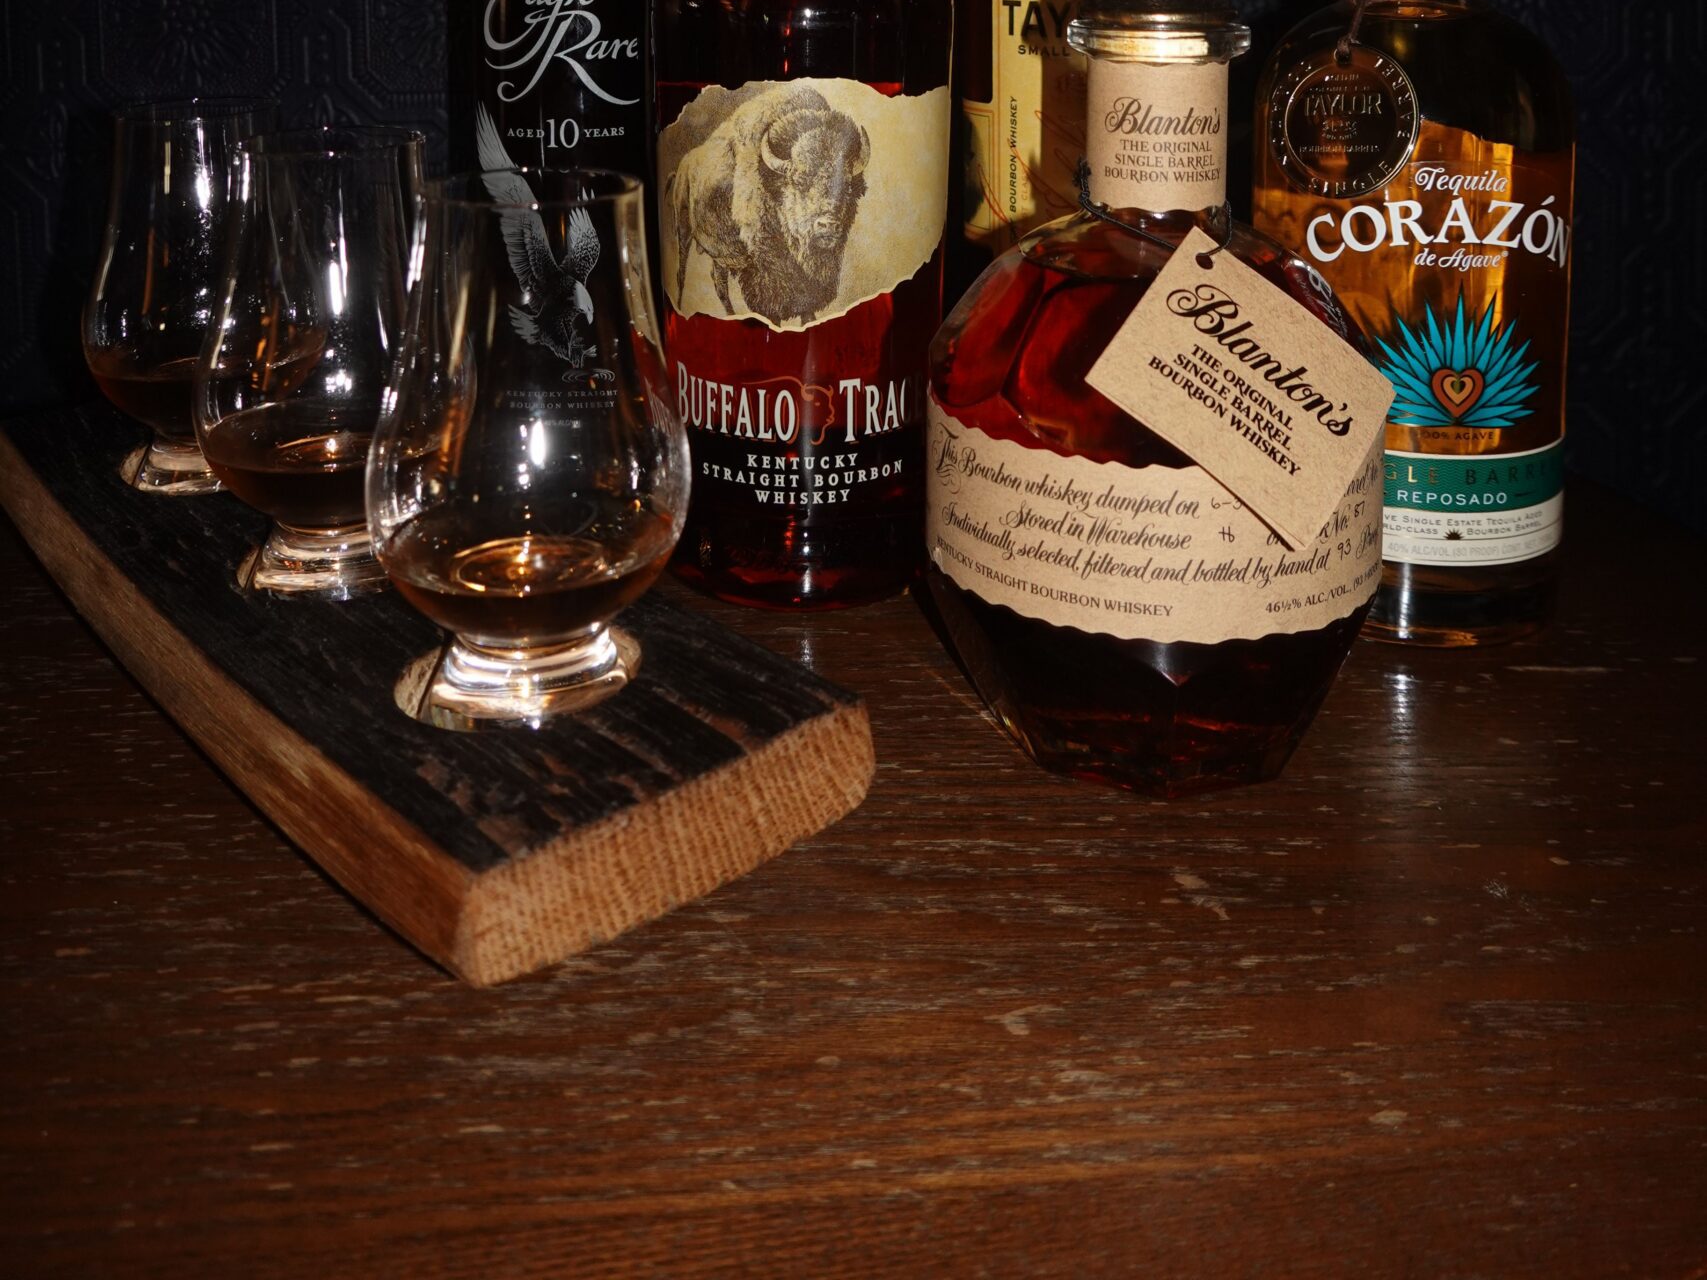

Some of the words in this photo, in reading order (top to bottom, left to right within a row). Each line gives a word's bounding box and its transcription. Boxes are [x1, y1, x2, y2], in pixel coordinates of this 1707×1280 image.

[1002, 0, 1072, 38] TAY
[497, 9, 640, 105] Rare
[1018, 44, 1071, 57] SMALL
[1009, 96, 1018, 148] WHISKEY
[1104, 96, 1220, 136] Blanton's
[1304, 92, 1382, 117] TAYLOR
[507, 128, 545, 138] AGED
[546, 118, 580, 148] 10
[584, 126, 625, 138] YEARS
[1120, 138, 1149, 152] THE
[1152, 140, 1212, 155] ORIGINAL
[1104, 166, 1169, 183] BOURBON
[1173, 170, 1221, 182] WHISKEY
[1114, 153, 1162, 168] SINGLE
[1168, 156, 1215, 169] BARREL
[1310, 161, 1393, 195] SINGLE
[1009, 155, 1017, 213] BOURBON
[1414, 167, 1508, 196] Tequila
[1306, 195, 1571, 268] CORAZÓN
[1414, 248, 1436, 267] de
[1166, 283, 1353, 437] Blanton's
[677, 360, 796, 442] BUFFALO
[1173, 353, 1229, 400] SINGLE
[1230, 396, 1291, 451] BARREL
[1192, 344, 1221, 372] THE
[1223, 368, 1294, 431] ORIGINAL
[1148, 355, 1228, 419] BOURBON
[1229, 415, 1301, 478] WHISKEY
[1423, 431, 1449, 440] 00%
[1455, 430, 1494, 440] AGAVE
[703, 462, 799, 487] STRAIGHT
[814, 459, 903, 487] BOURBON
[747, 453, 858, 470] KENTUCKY
[1384, 464, 1439, 485] GLE
[1464, 462, 1550, 485] BARRE
[755, 489, 849, 505] WHISKEY
[958, 446, 1025, 492] Bourbon
[1025, 474, 1094, 514] whiskey
[1095, 485, 1178, 520] dumped
[1176, 500, 1201, 520] on
[1210, 496, 1243, 510] 6-3
[1396, 489, 1508, 506] REPOSADO
[999, 501, 1071, 533] Stored
[1068, 515, 1084, 542] in
[1087, 517, 1192, 549] Warehouse
[1354, 501, 1365, 518] 87
[942, 501, 1016, 560] Individually
[1080, 552, 1152, 582] filtered
[1150, 558, 1192, 586] and
[1193, 558, 1252, 585] bottled
[1251, 557, 1273, 588] by
[1274, 549, 1318, 578] hand
[1315, 548, 1332, 572] at
[1337, 538, 1351, 560] 93
[936, 536, 973, 568] KENTUCKY
[974, 563, 1028, 592] STRAIGHT
[1030, 583, 1101, 608] BOURBON
[1104, 599, 1173, 617] WHISKEY
